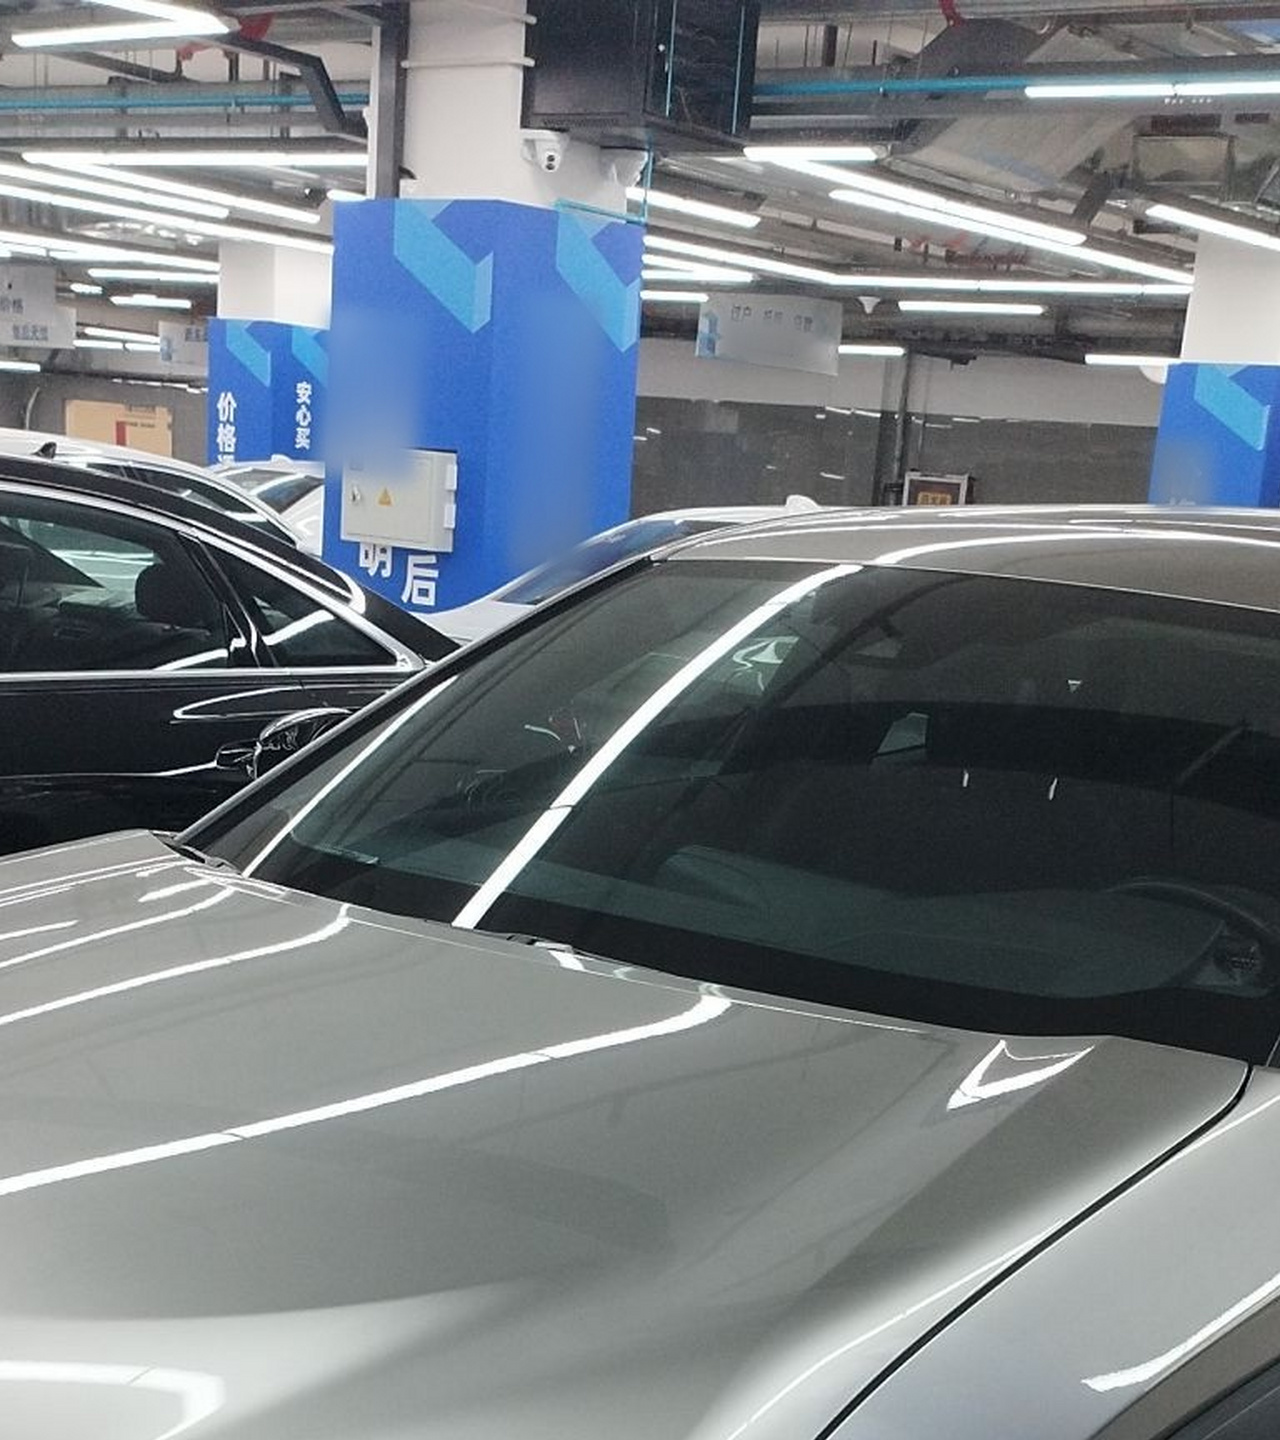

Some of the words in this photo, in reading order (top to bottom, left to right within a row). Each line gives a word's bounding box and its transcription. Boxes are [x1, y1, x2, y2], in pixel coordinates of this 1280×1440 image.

[217, 391, 237, 465] 价格
[294, 381, 312, 450] 安心买
[400, 554, 439, 606] 后
